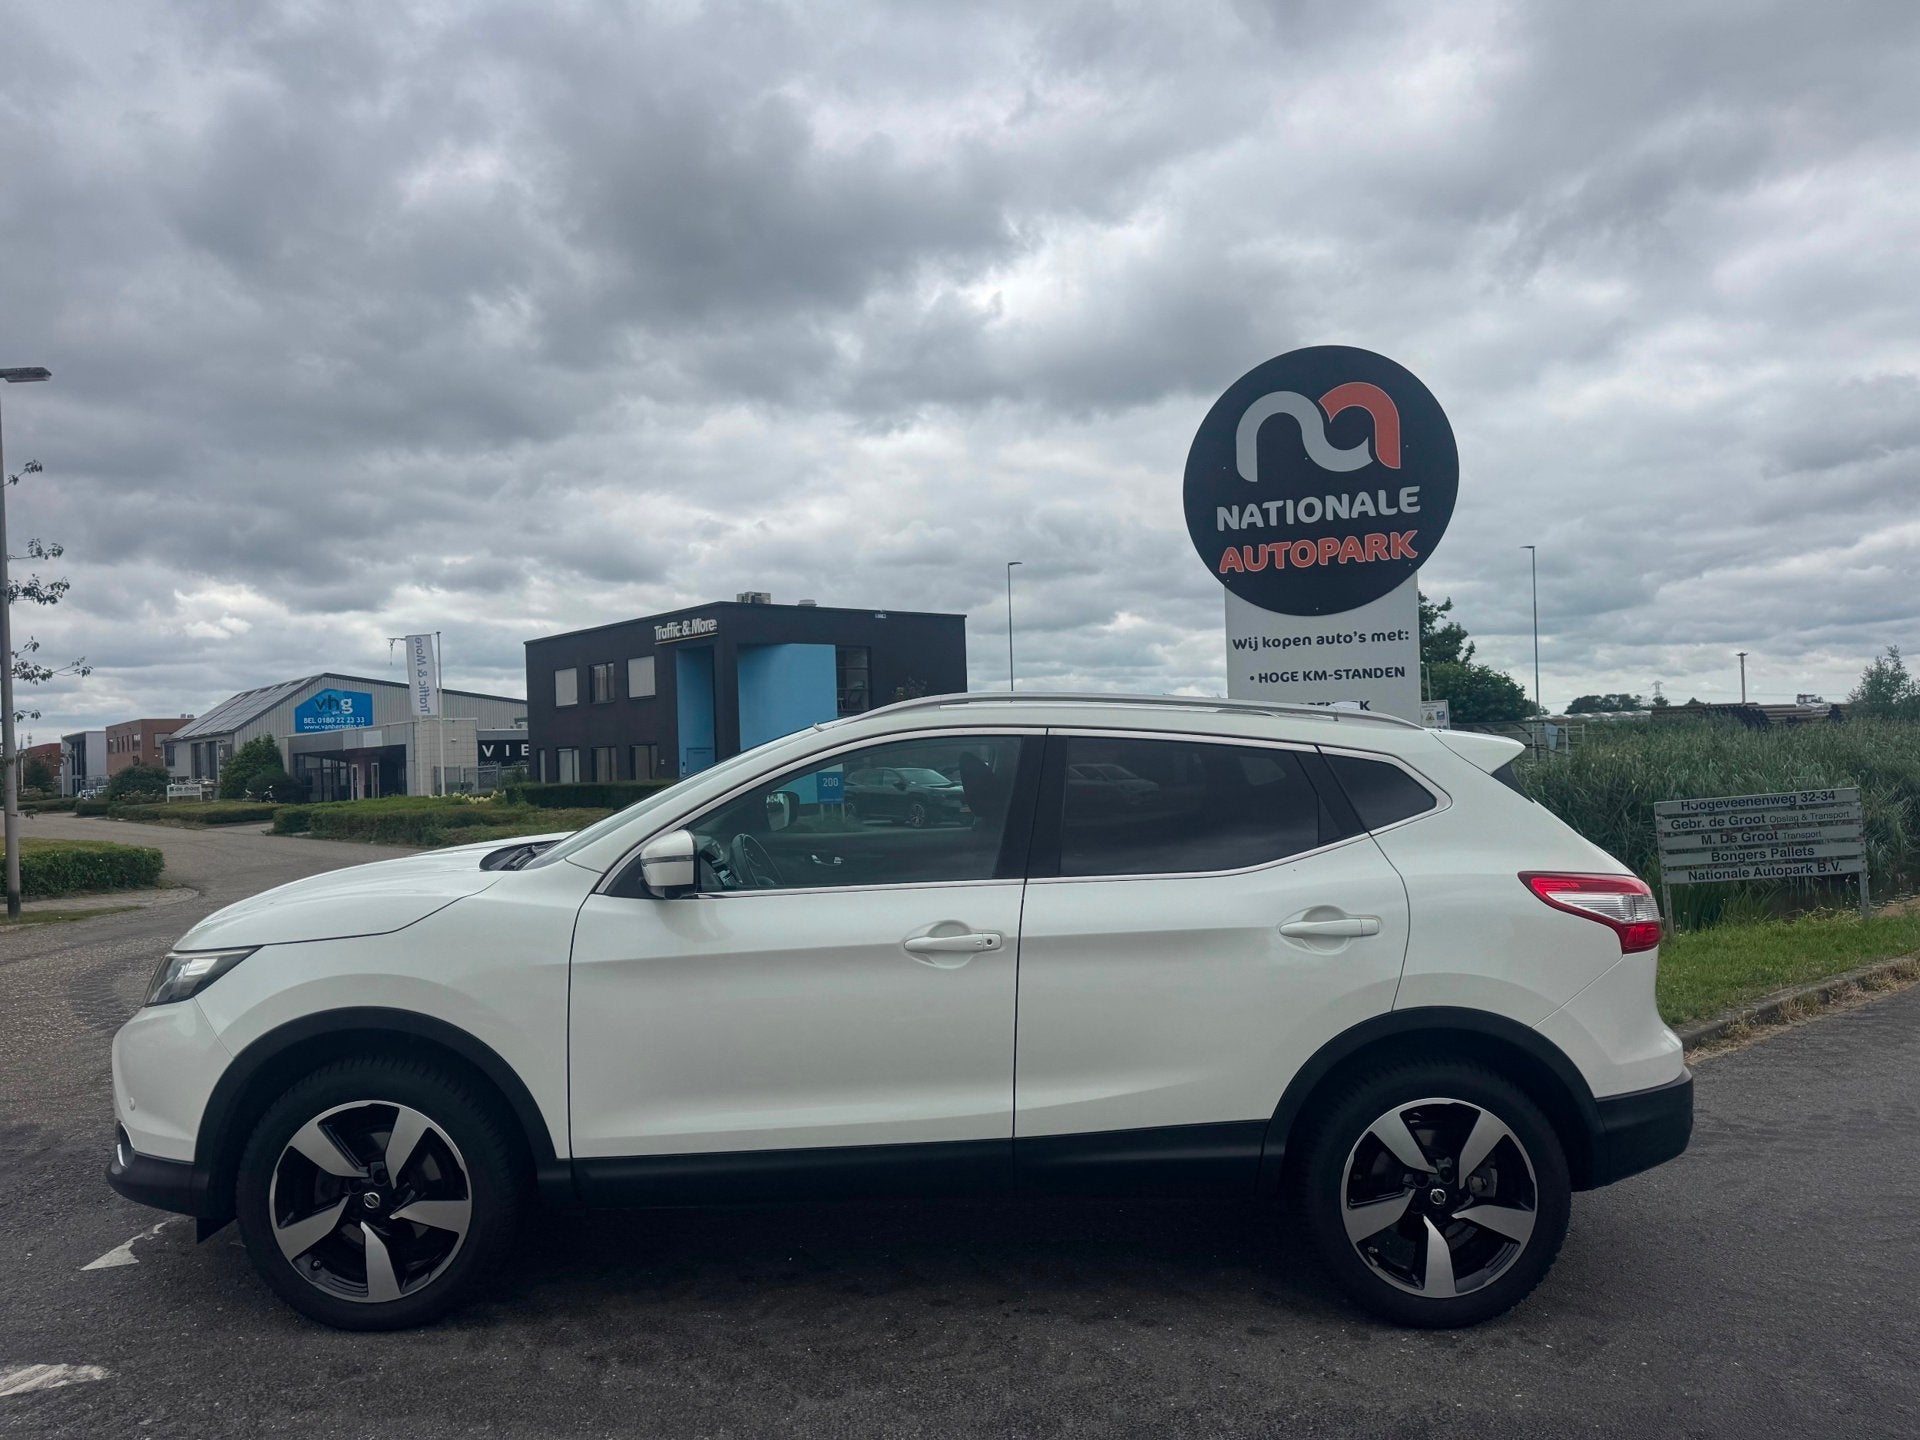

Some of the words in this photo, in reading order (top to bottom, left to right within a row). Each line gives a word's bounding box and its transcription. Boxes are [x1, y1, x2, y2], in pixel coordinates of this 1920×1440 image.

[1216, 485, 1421, 531] NATIONALE
[1219, 530, 1419, 574] AUTOPARK
[654, 622, 682, 640] Traffic
[682, 620, 691, 636] &
[691, 618, 717, 633] More
[1232, 636, 1258, 651] Wij
[1262, 636, 1312, 649] kopen
[1316, 631, 1366, 645] auto's
[1371, 629, 1410, 643] met:
[1258, 671, 1299, 684] HOGE
[1303, 666, 1405, 682] KM-STANDEN
[822, 777, 839, 787] 200
[1681, 794, 1797, 812] Hoogeveenenweg
[1800, 790, 1836, 803] 32-34
[1671, 818, 1705, 830] Gebr.
[1709, 816, 1725, 827] de
[1728, 813, 1766, 826] Groot
[1801, 813, 1807, 821] &
[1810, 811, 1850, 821] Transport
[1701, 835, 1716, 845] M.
[1720, 833, 1737, 844] De
[1741, 830, 1779, 842] Groot
[1783, 830, 1822, 840] Transport
[1711, 850, 1767, 863] Bongers
[1770, 846, 1815, 858] Pallets
[1688, 867, 1750, 881] Nationale
[1753, 863, 1813, 877] Autopark
[1817, 861, 1842, 873] B.V.
